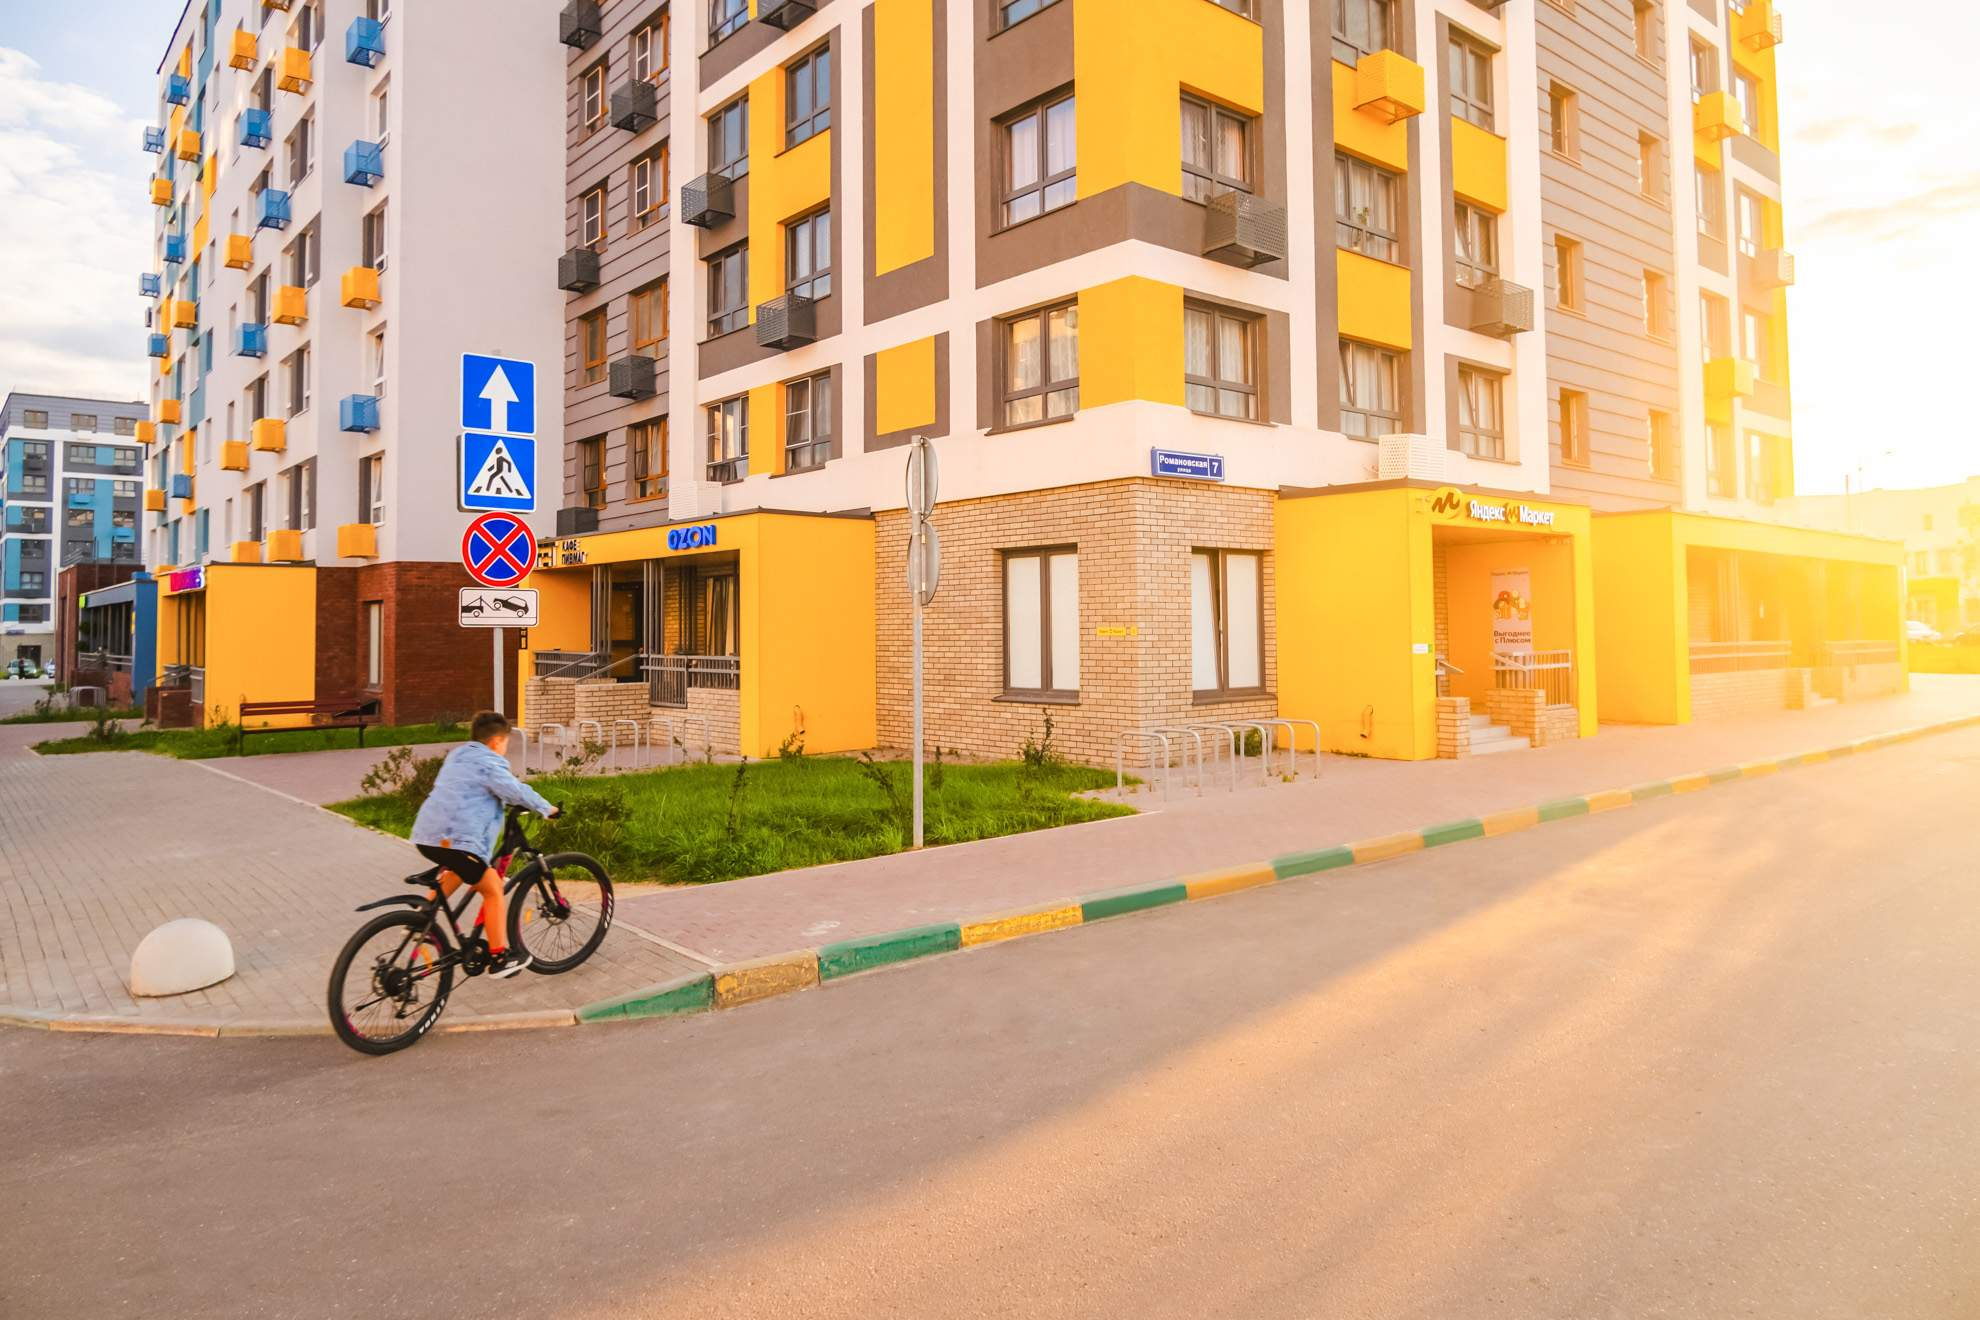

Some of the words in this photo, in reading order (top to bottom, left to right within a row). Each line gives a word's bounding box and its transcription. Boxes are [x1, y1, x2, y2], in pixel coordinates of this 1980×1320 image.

[1159, 455, 1208, 469] Романовская
[1212, 461, 1219, 474] 7
[1469, 499, 1506, 522] Яндекс
[1519, 504, 1554, 526] Маркет
[562, 539, 577, 550] КАФЕ
[668, 525, 716, 550] OZON
[1493, 630, 1531, 638] Выгоднее
[1500, 636, 1531, 645] Плюсом
